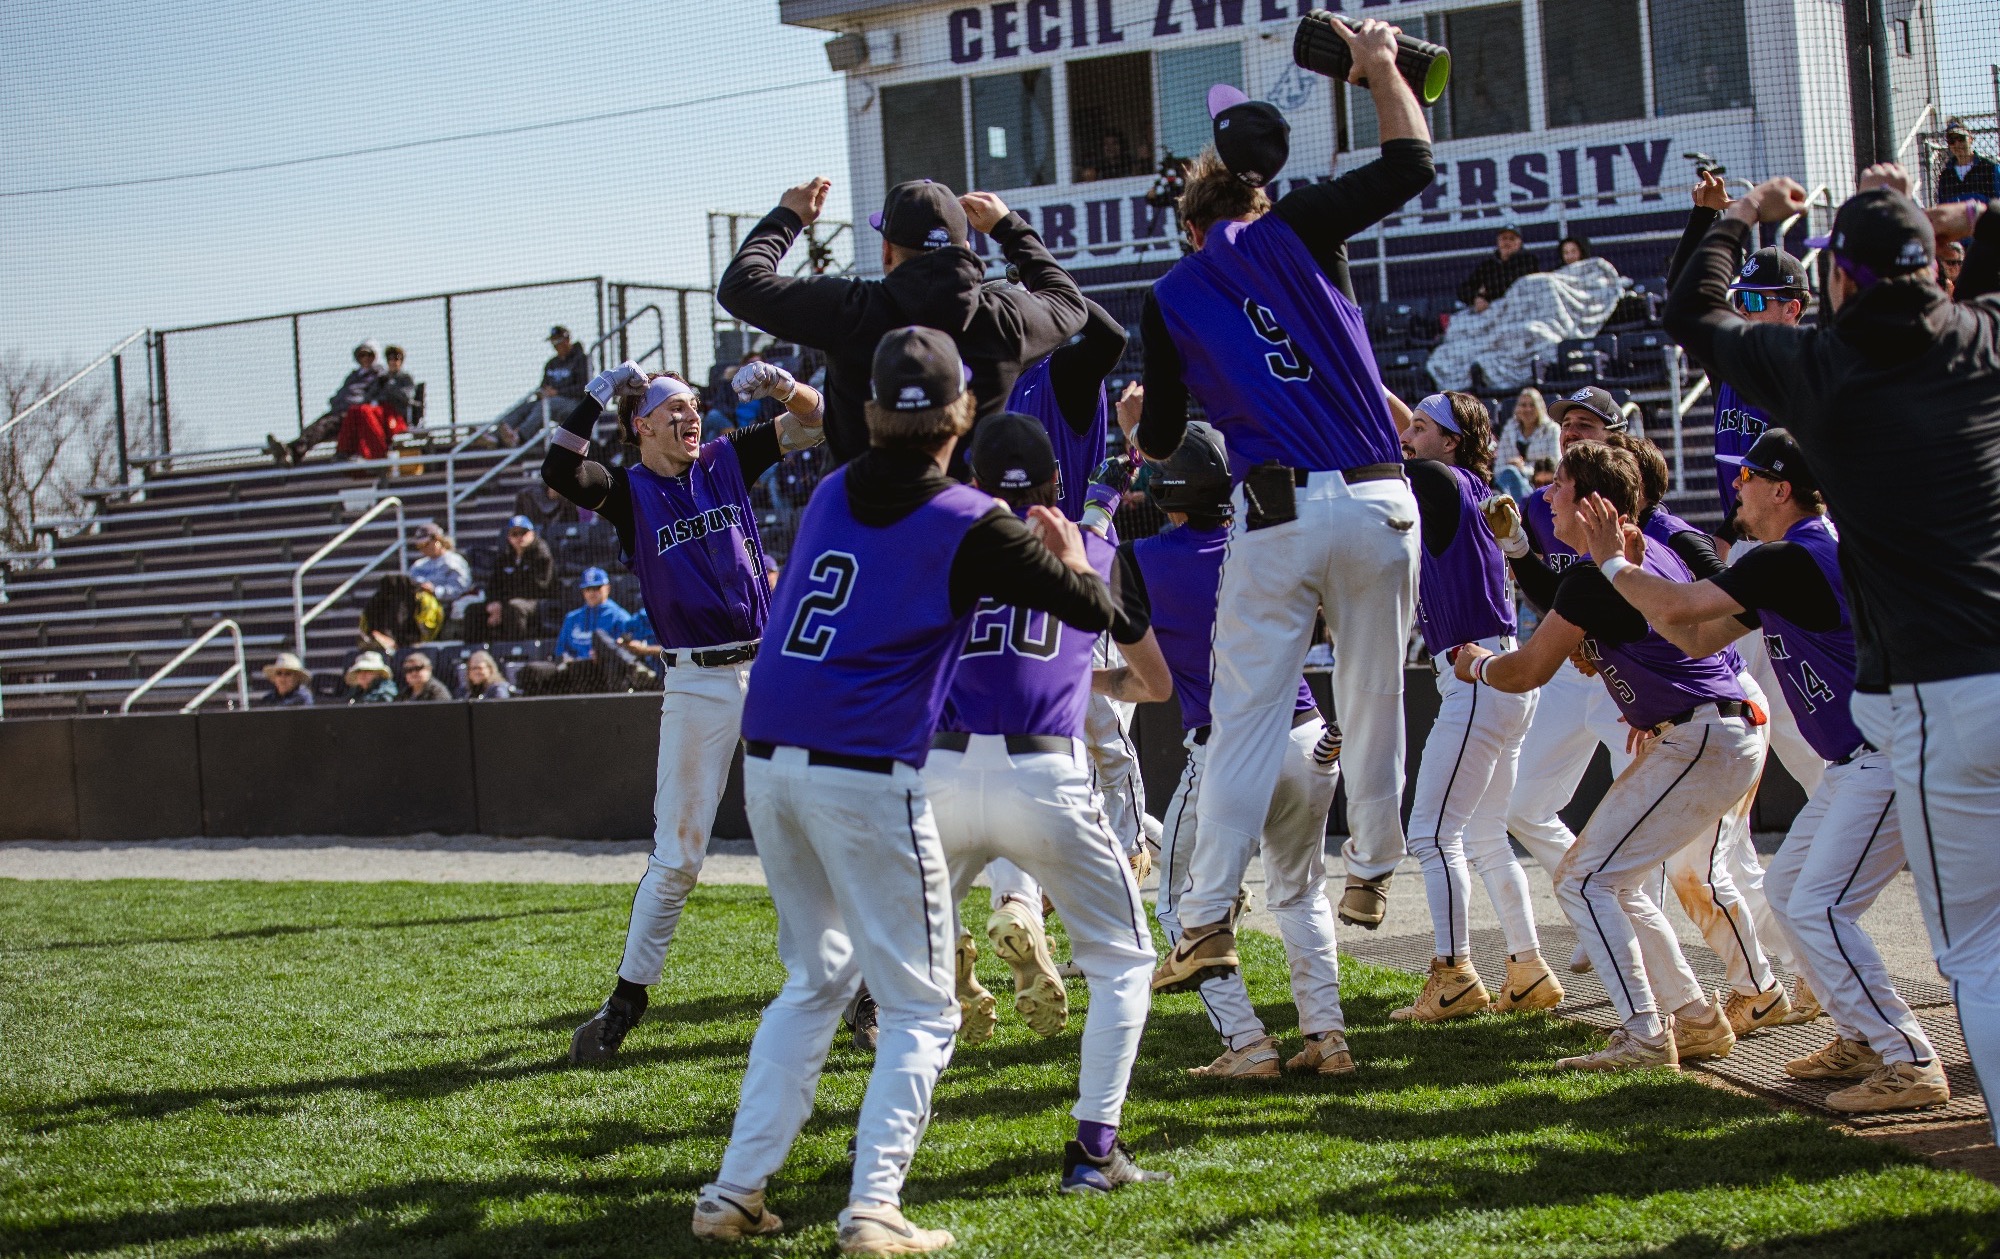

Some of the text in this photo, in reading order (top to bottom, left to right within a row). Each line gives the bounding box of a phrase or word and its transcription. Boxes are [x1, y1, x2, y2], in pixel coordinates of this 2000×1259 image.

[949, 0, 1124, 64] CECIL
[1243, 297, 1313, 382] 9
[780, 549, 859, 661] 2
[1604, 664, 1636, 704] 5
